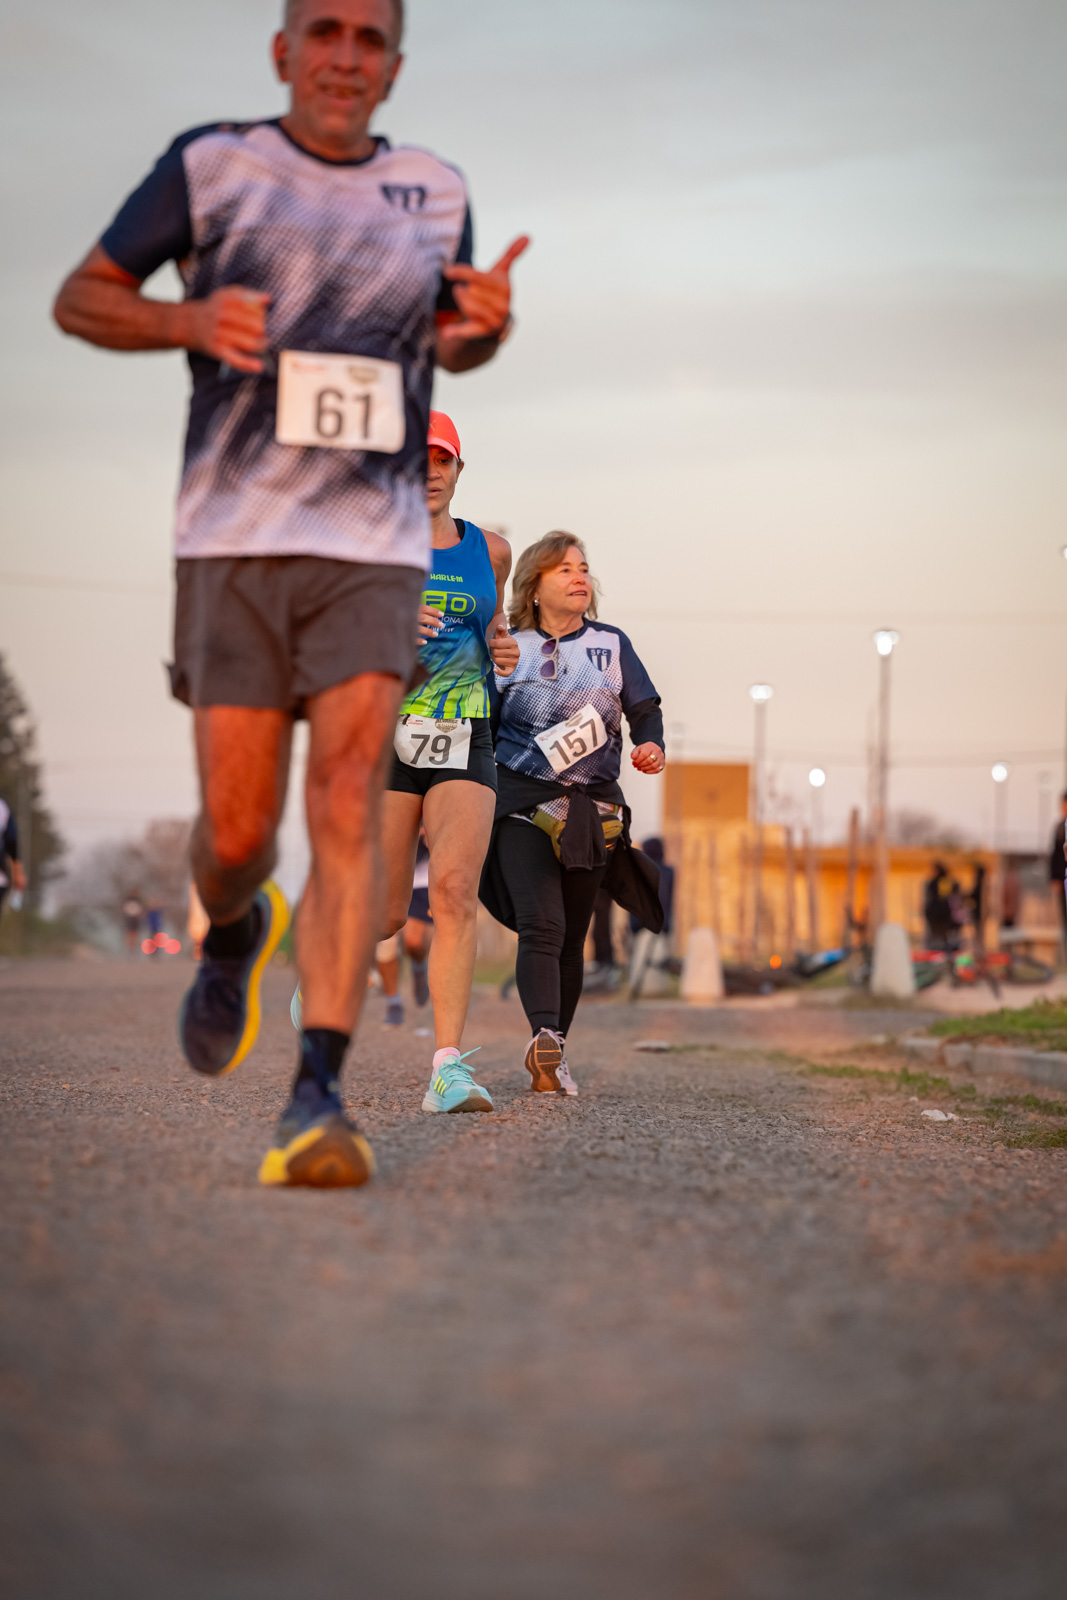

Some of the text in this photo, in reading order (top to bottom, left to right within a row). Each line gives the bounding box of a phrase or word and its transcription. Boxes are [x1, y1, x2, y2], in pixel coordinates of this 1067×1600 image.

[314, 386, 372, 440] 61
[430, 573, 464, 583] HARLEM
[410, 733, 452, 766] 79
[549, 718, 598, 766] 157
